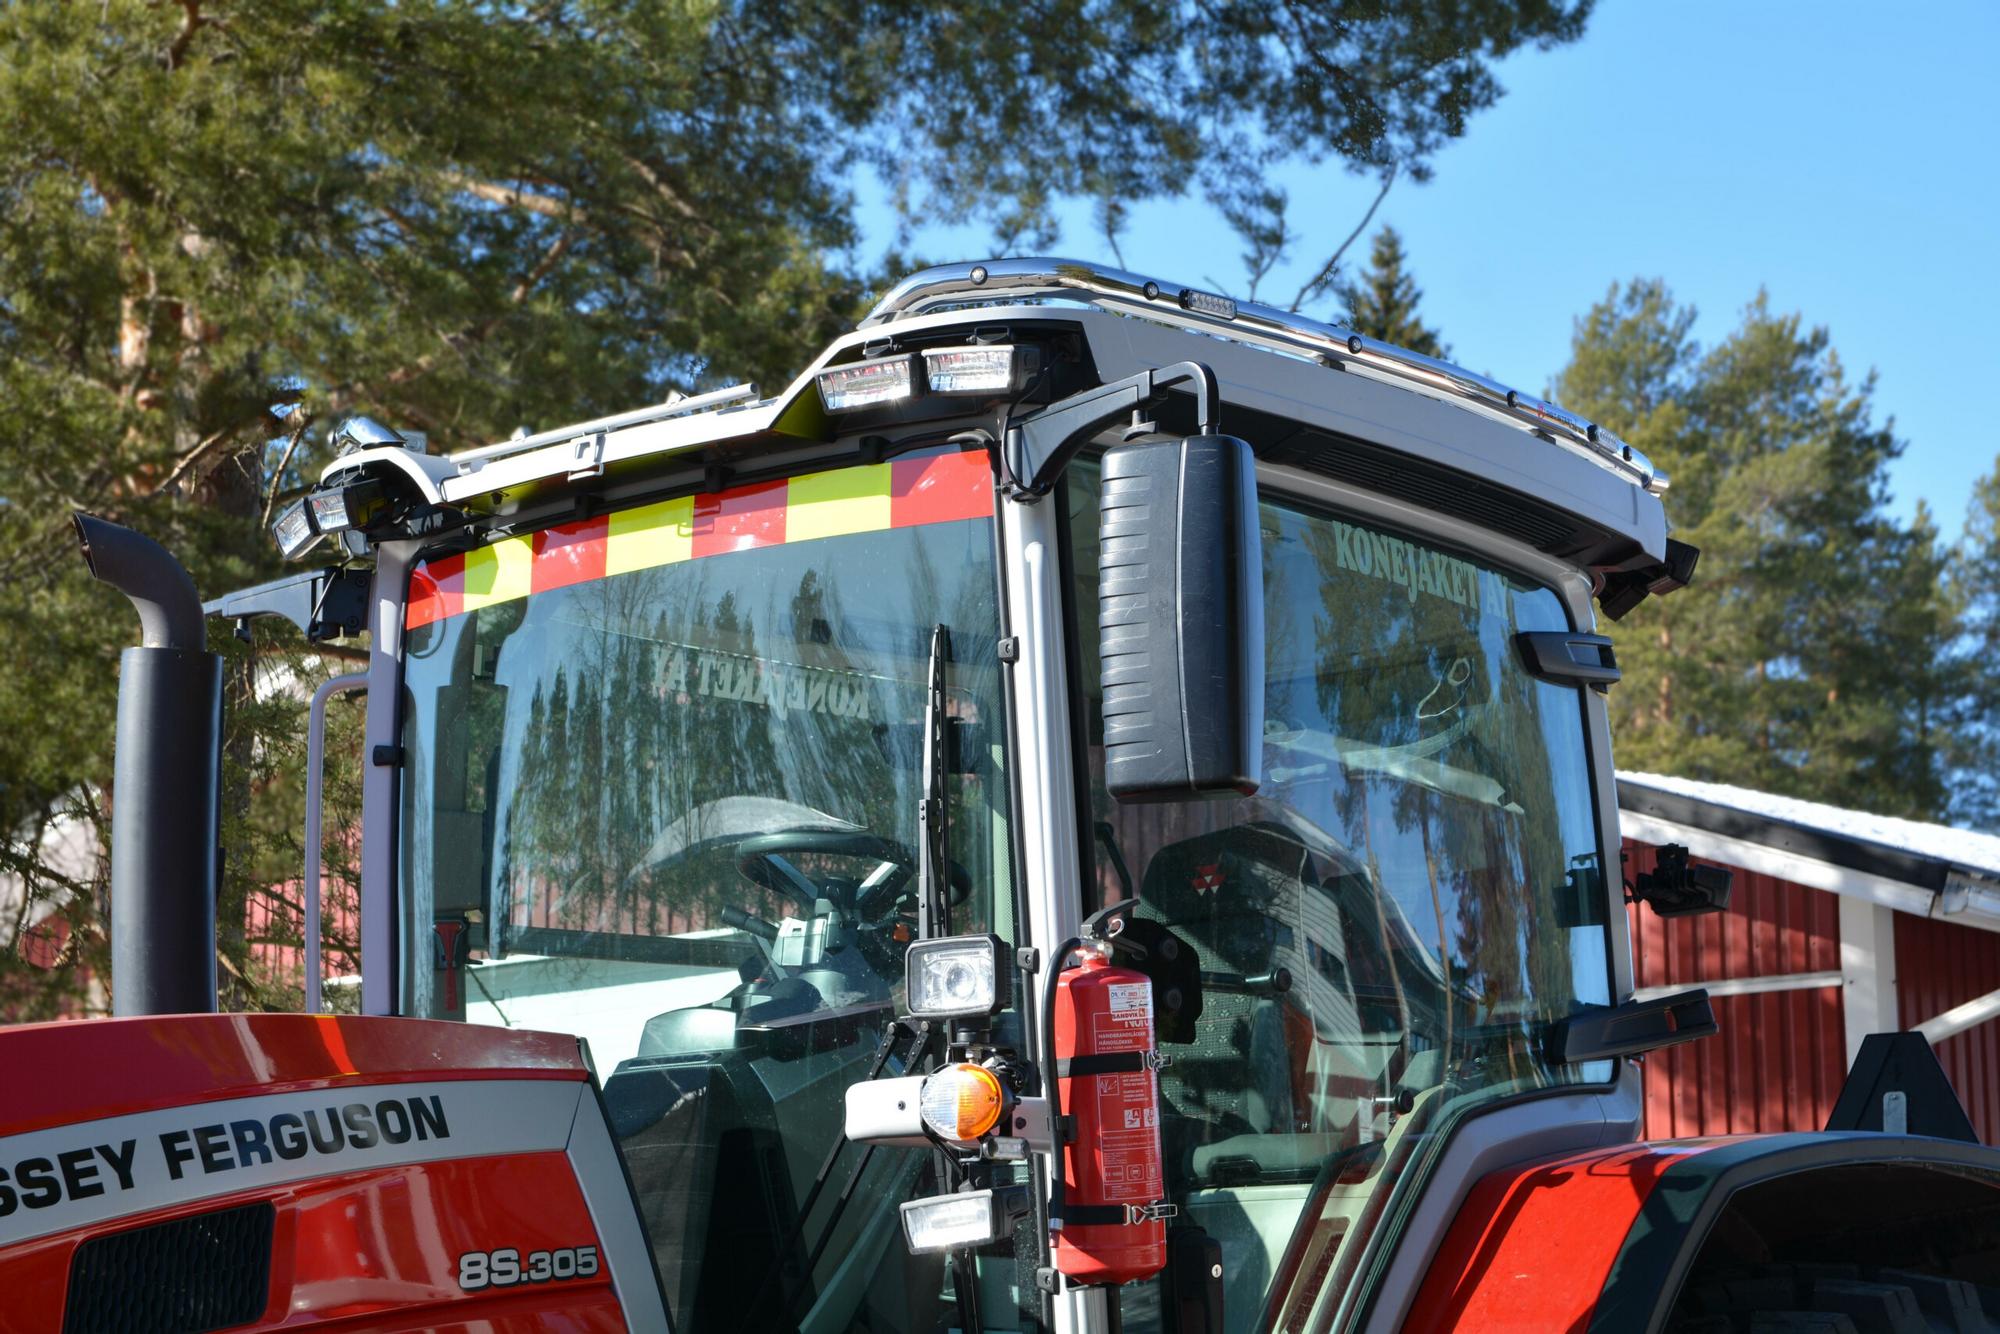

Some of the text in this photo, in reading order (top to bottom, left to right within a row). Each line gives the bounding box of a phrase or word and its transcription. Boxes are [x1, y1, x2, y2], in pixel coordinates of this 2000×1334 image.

[1332, 520, 1478, 609] KONEJAKET
[159, 1095, 450, 1180] FERGUSON
[458, 1245, 599, 1291] 8S.305
